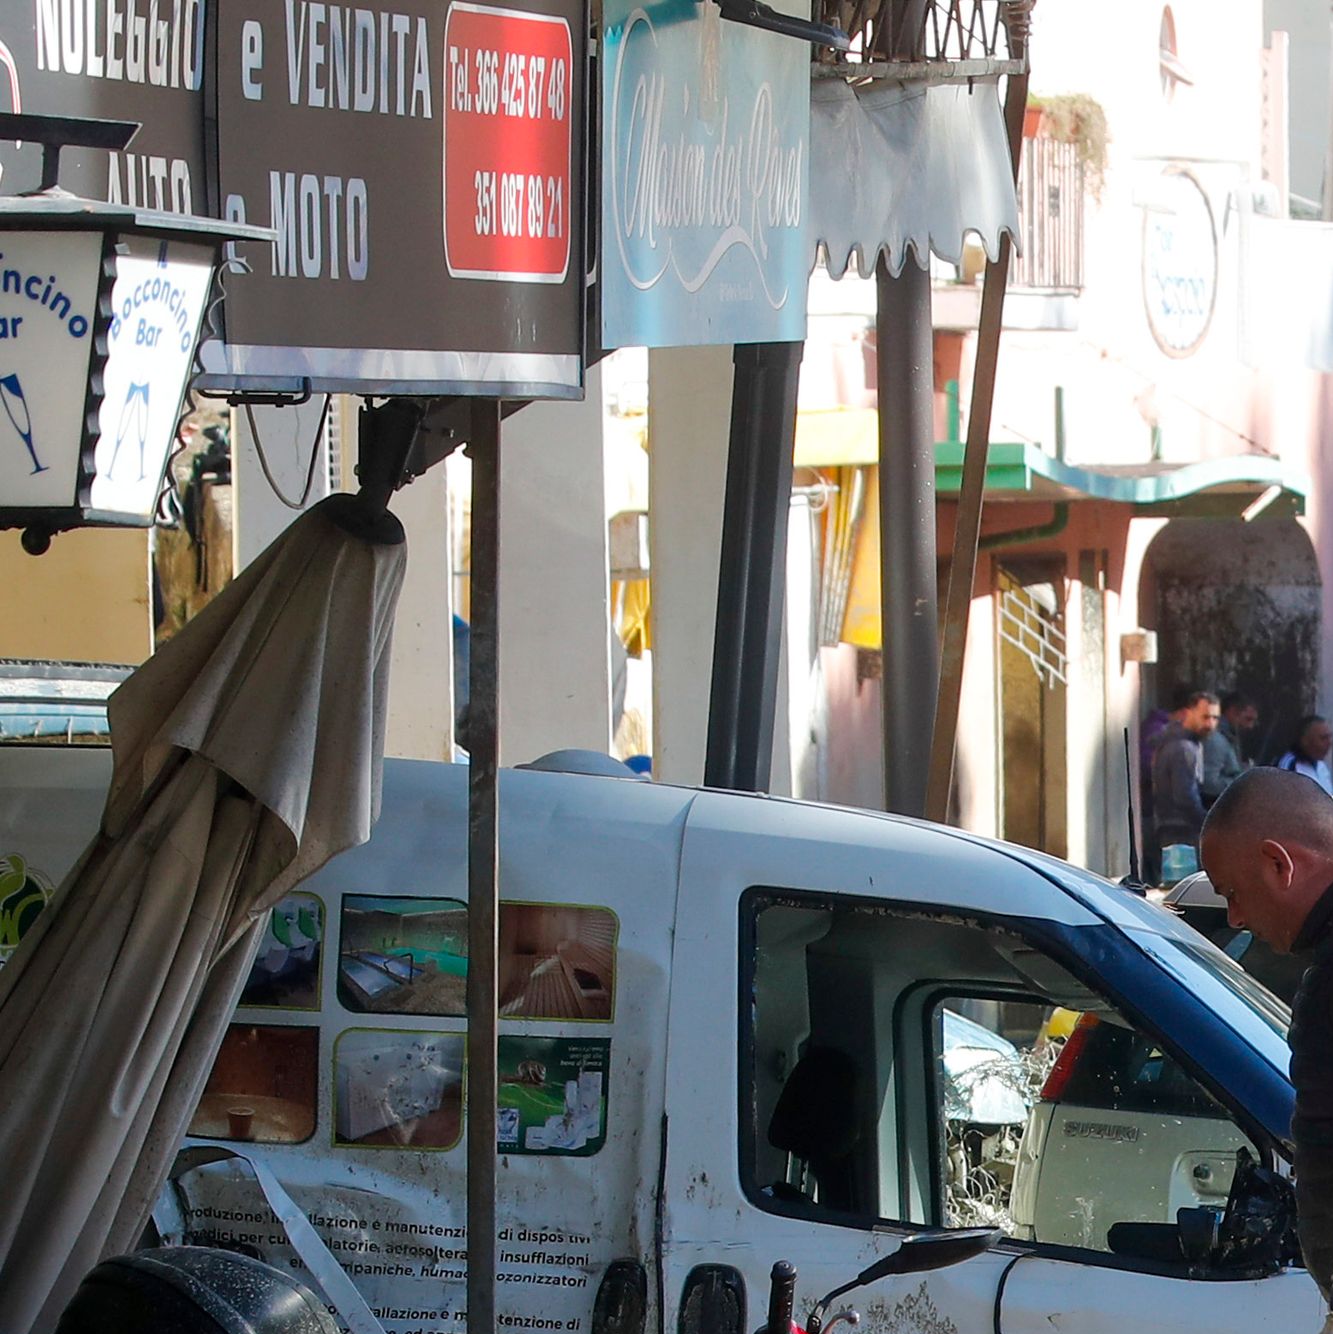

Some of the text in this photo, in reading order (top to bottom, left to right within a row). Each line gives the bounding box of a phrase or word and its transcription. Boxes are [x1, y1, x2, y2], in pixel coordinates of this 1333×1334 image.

[37, 0, 432, 119] NOLEGGIO e VENDITA
[450, 46, 565, 120] Tel. 366 425 87 48
[711, 96, 742, 228] des
[270, 171, 368, 280] MOTO
[475, 170, 562, 238] 351 087 89 21
[111, 277, 191, 353] Bocconcino
[136, 318, 163, 347] Bar
[1064, 1120, 1140, 1142] SUZUKI
[498, 1228, 513, 1241] di
[500, 1250, 589, 1267] insufflazioni
[496, 1273, 587, 1288] ozonizzatori
[566, 1318, 581, 1331] di
